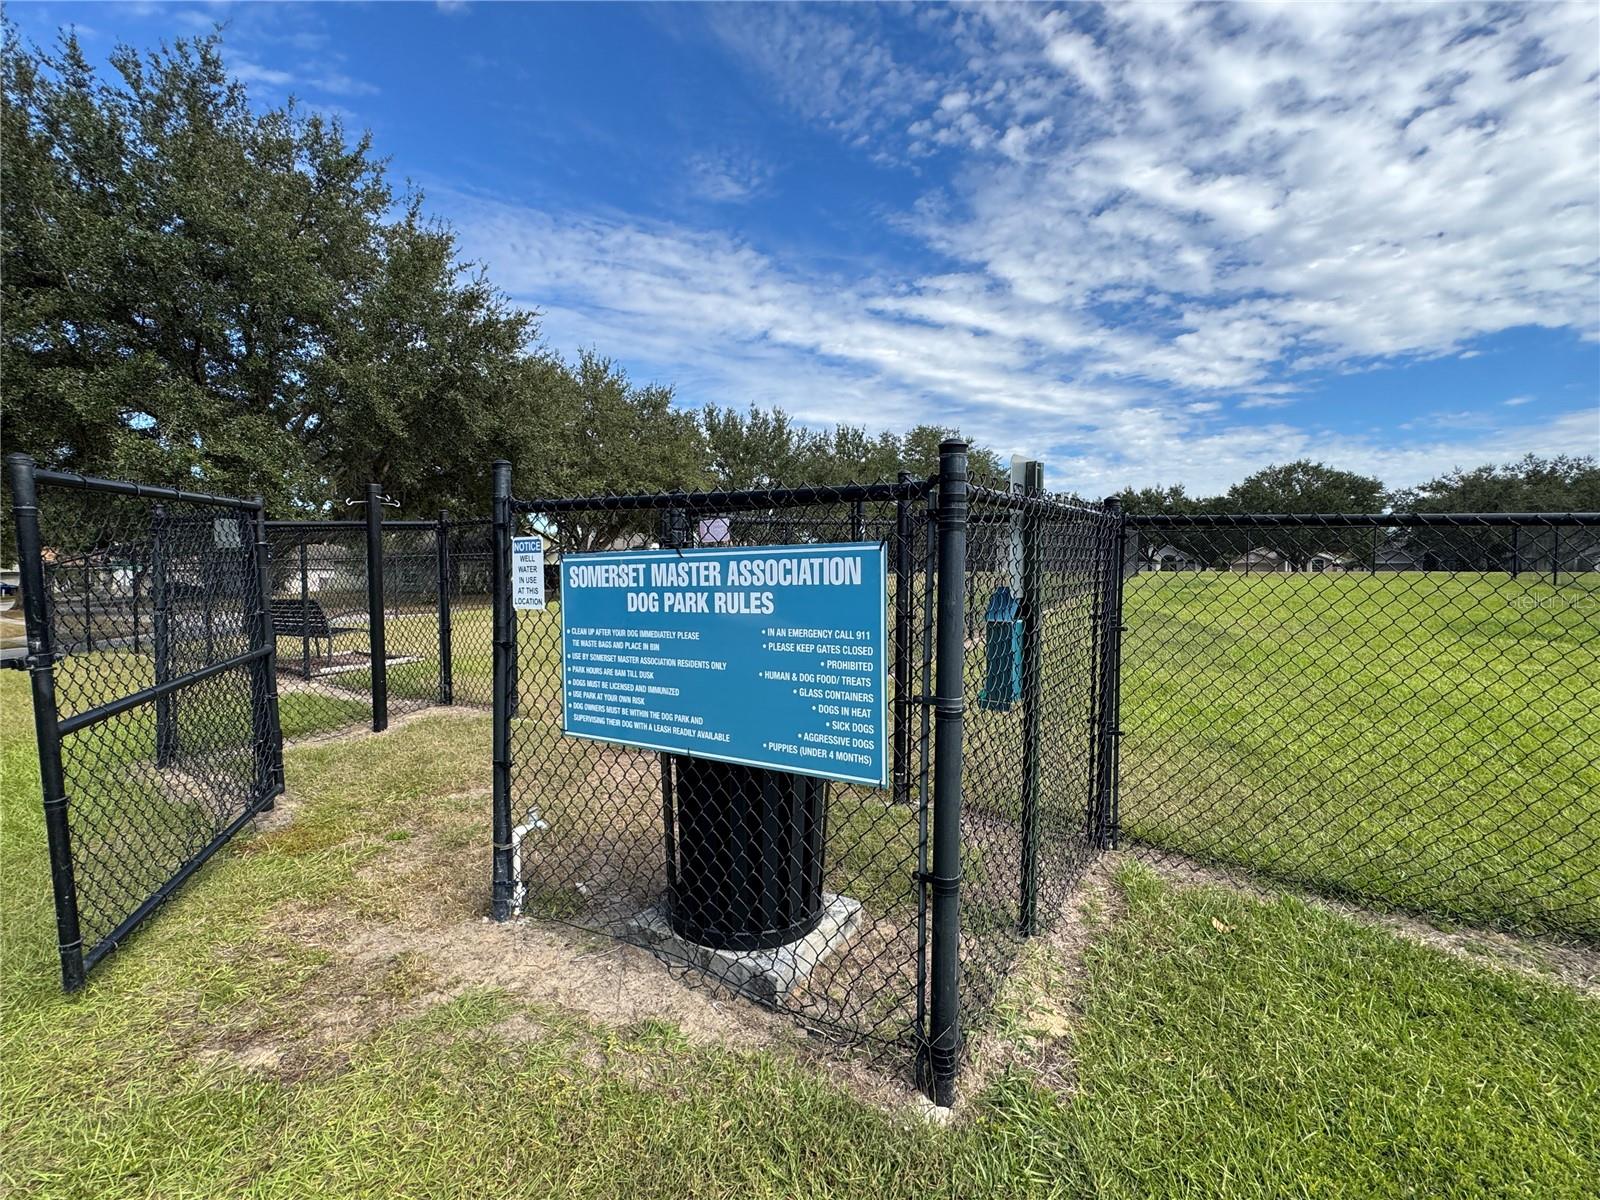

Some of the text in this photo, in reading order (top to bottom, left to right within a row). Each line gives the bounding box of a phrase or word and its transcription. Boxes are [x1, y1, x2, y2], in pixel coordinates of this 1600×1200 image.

[514, 541, 541, 552] NOTICE
[570, 557, 861, 588] SOMERSET MASTER ASSOCIATION
[627, 592, 774, 614] DOG PARK RULES
[595, 628, 611, 636] AFTER
[612, 629, 626, 637] YOUR
[640, 630, 676, 639] IMMEDIATELY
[677, 632, 700, 640] PLEASE
[768, 628, 870, 640] IN AN EMERGENCY CALL 911
[613, 641, 623, 649] AND
[625, 642, 641, 650] PLACE
[650, 643, 659, 651] BIN
[769, 642, 873, 656] PLEASE KEEP GATES CLOSED
[590, 653, 616, 662] SOMERSET
[618, 655, 639, 663] MASTER
[640, 657, 676, 667] ASSOCIATION
[677, 659, 709, 669] RESIDENTS
[711, 662, 727, 670] ONLY
[827, 660, 873, 671] PROHIBITED
[586, 667, 603, 675] HOURS
[627, 670, 638, 678] TILL
[639, 671, 654, 679] DUSK
[765, 671, 871, 687] HUMAN & DOG FOOD/ TREATS
[610, 682, 634, 691] LICENSED
[648, 686, 679, 696] IMMUNIZED
[800, 688, 874, 703] GLASS CONTAINERS
[604, 694, 618, 702] YOUR
[619, 695, 631, 703] OWN
[632, 697, 645, 705] RISK
[584, 704, 605, 712] OWNERS
[606, 706, 620, 714] MUST
[630, 709, 649, 718] WITHIN
[650, 711, 660, 719] THE
[661, 712, 673, 721] DOG
[674, 714, 689, 723] PARK
[691, 716, 703, 725] AND
[819, 705, 871, 718] DOGS IN HEAT
[574, 714, 605, 724] SUPERVISING
[606, 718, 620, 727] THEIR
[622, 720, 633, 728] DOG
[634, 722, 647, 730] WITH
[654, 724, 671, 734] LEASH
[673, 727, 696, 737] READILY
[697, 730, 730, 742] AVAILABLE
[832, 721, 874, 734] SICK DOGS
[804, 732, 874, 750] AGGRESSIVE DOGS
[769, 742, 871, 766] PUPPIES (UNDER 4 MONTHS)
